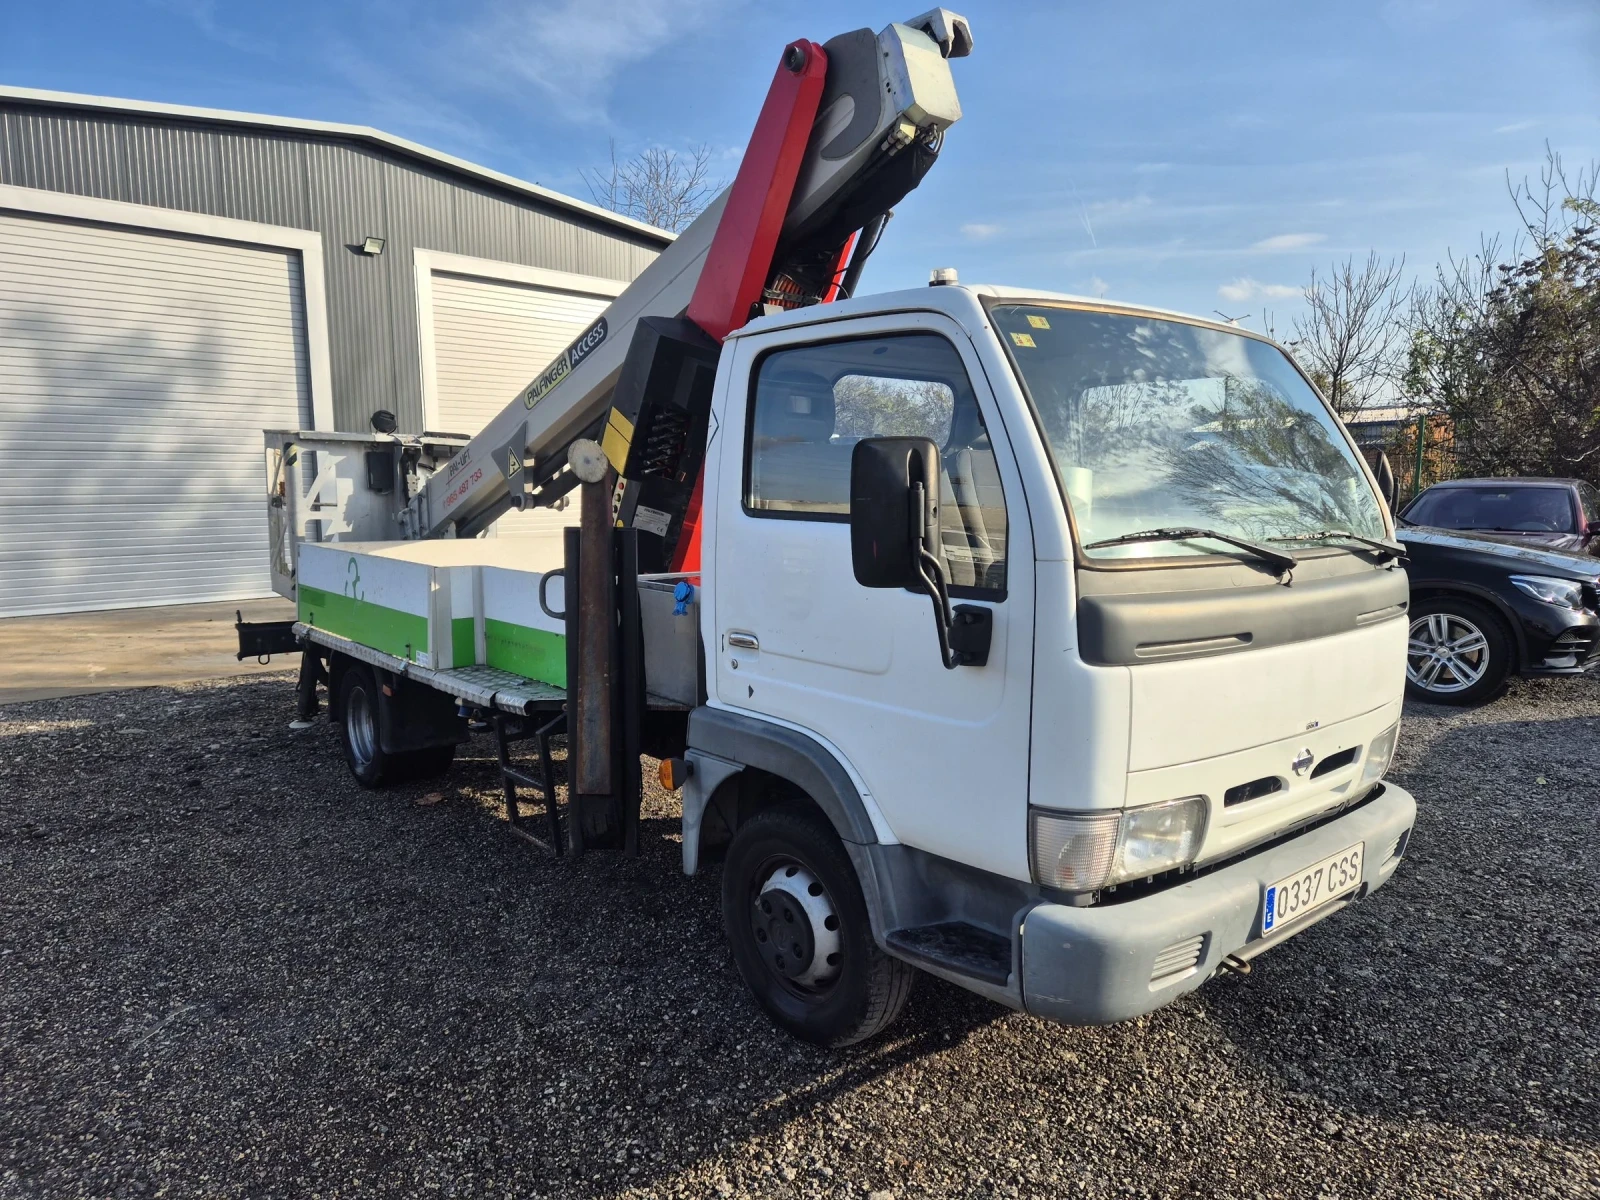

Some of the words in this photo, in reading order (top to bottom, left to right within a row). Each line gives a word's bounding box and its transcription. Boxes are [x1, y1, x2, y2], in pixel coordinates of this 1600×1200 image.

[526, 357, 568, 405] PALFINGER
[570, 322, 604, 365] ACCESS
[1277, 867, 1323, 919] 0337
[1327, 851, 1359, 893] CSS
